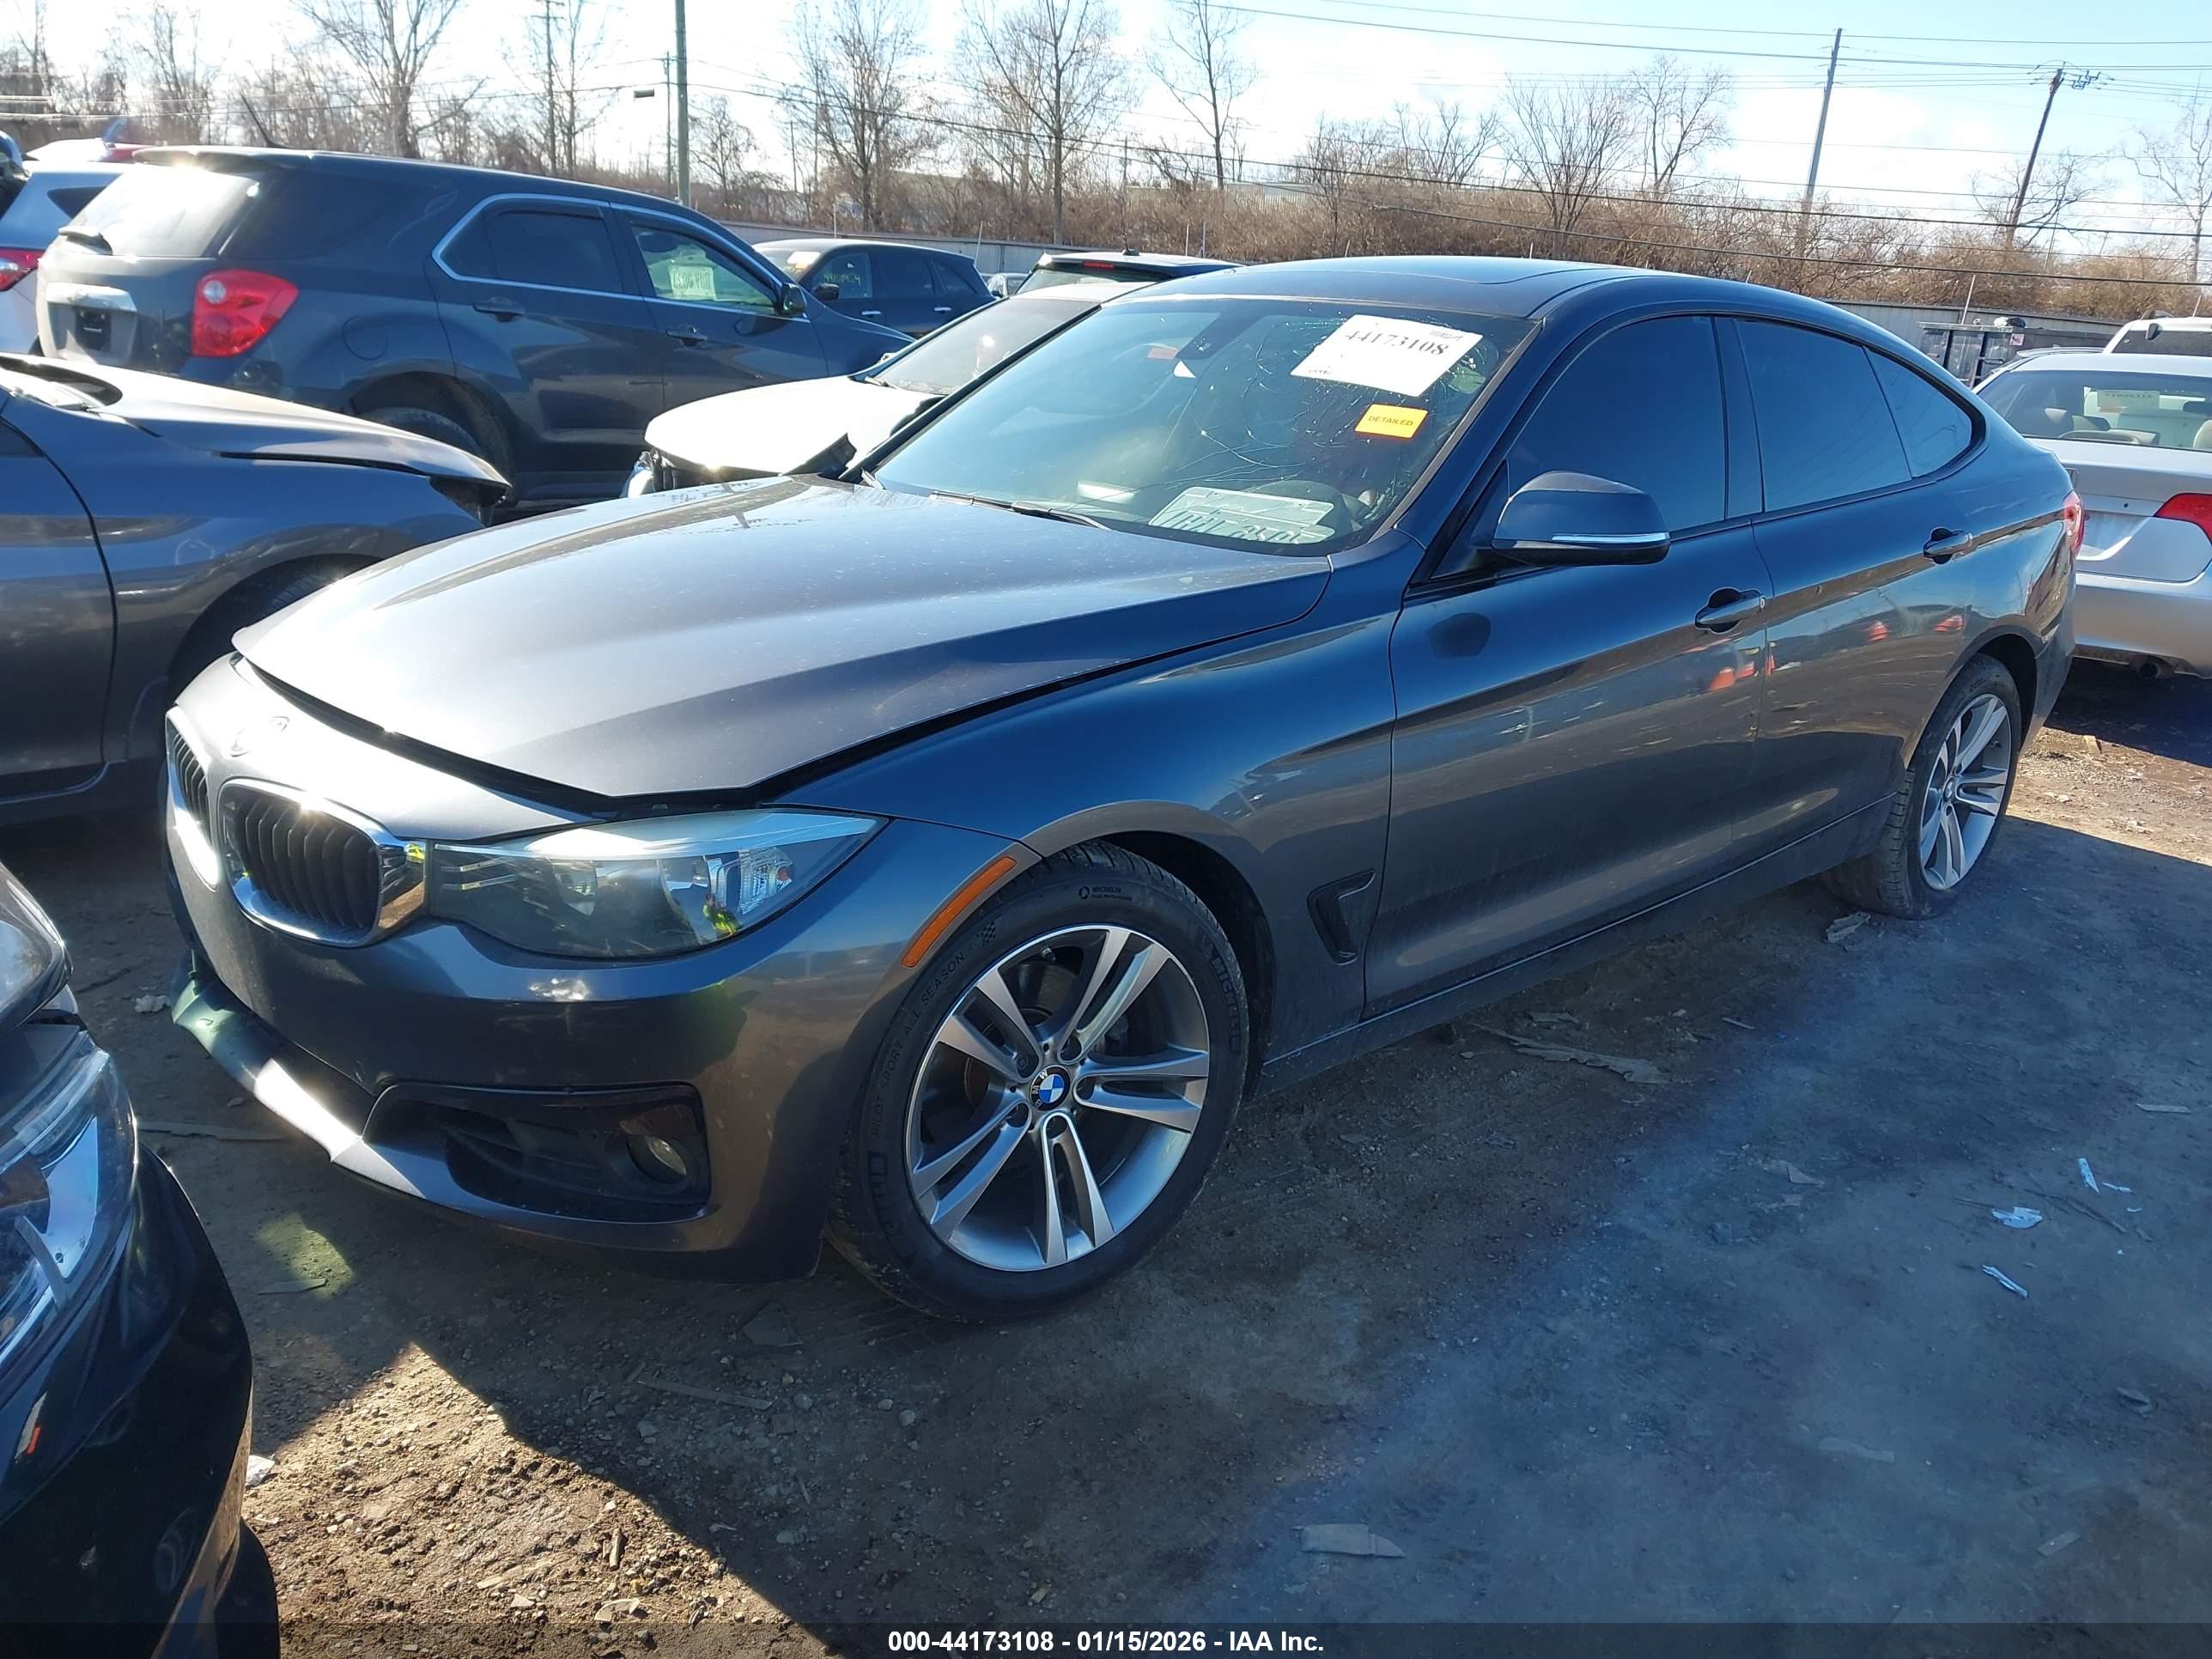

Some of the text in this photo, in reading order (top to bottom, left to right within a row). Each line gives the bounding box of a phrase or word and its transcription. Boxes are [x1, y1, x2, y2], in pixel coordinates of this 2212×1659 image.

[1344, 330, 1449, 356] 44173108
[1368, 416, 1414, 426] DETAILED
[881, 1042, 904, 1089] SPORT
[921, 951, 965, 1006] SEASON
[1031, 1069, 1048, 1108] BMW
